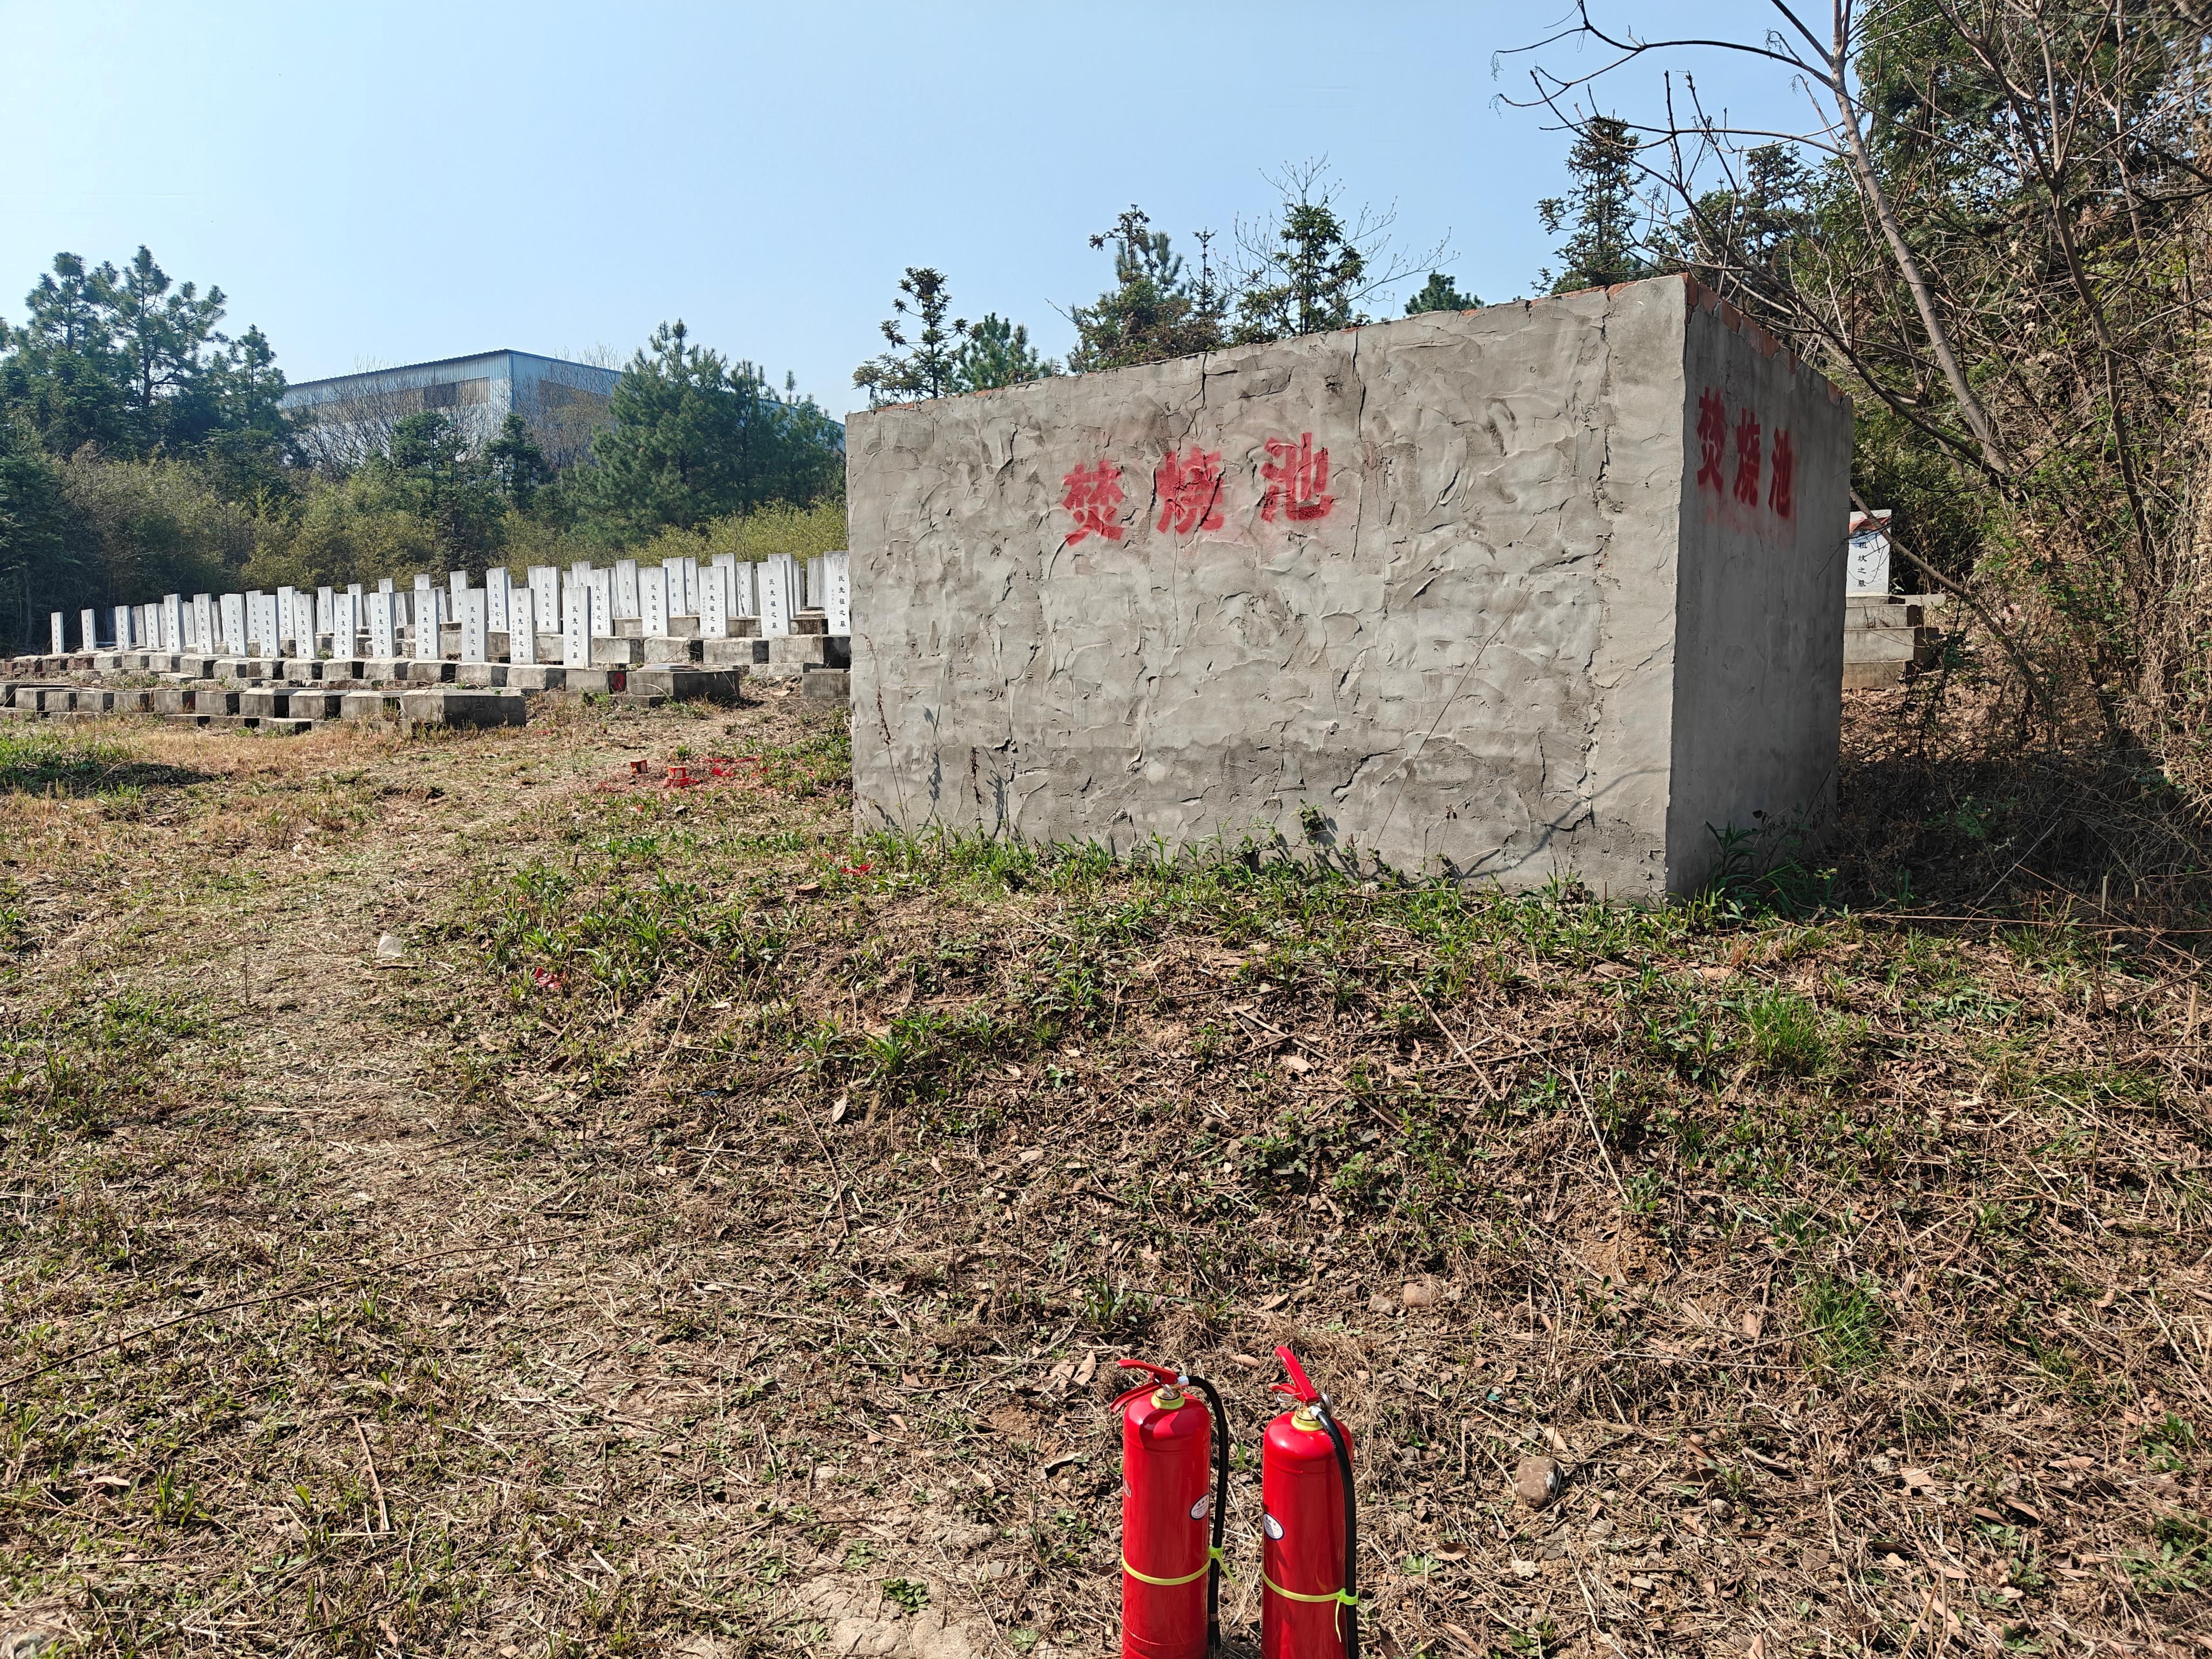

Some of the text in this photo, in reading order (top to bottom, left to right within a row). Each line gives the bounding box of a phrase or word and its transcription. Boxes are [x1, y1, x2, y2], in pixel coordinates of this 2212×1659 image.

[1062, 432, 1334, 547] 焚烧池
[1697, 387, 1792, 519] 焚烧池
